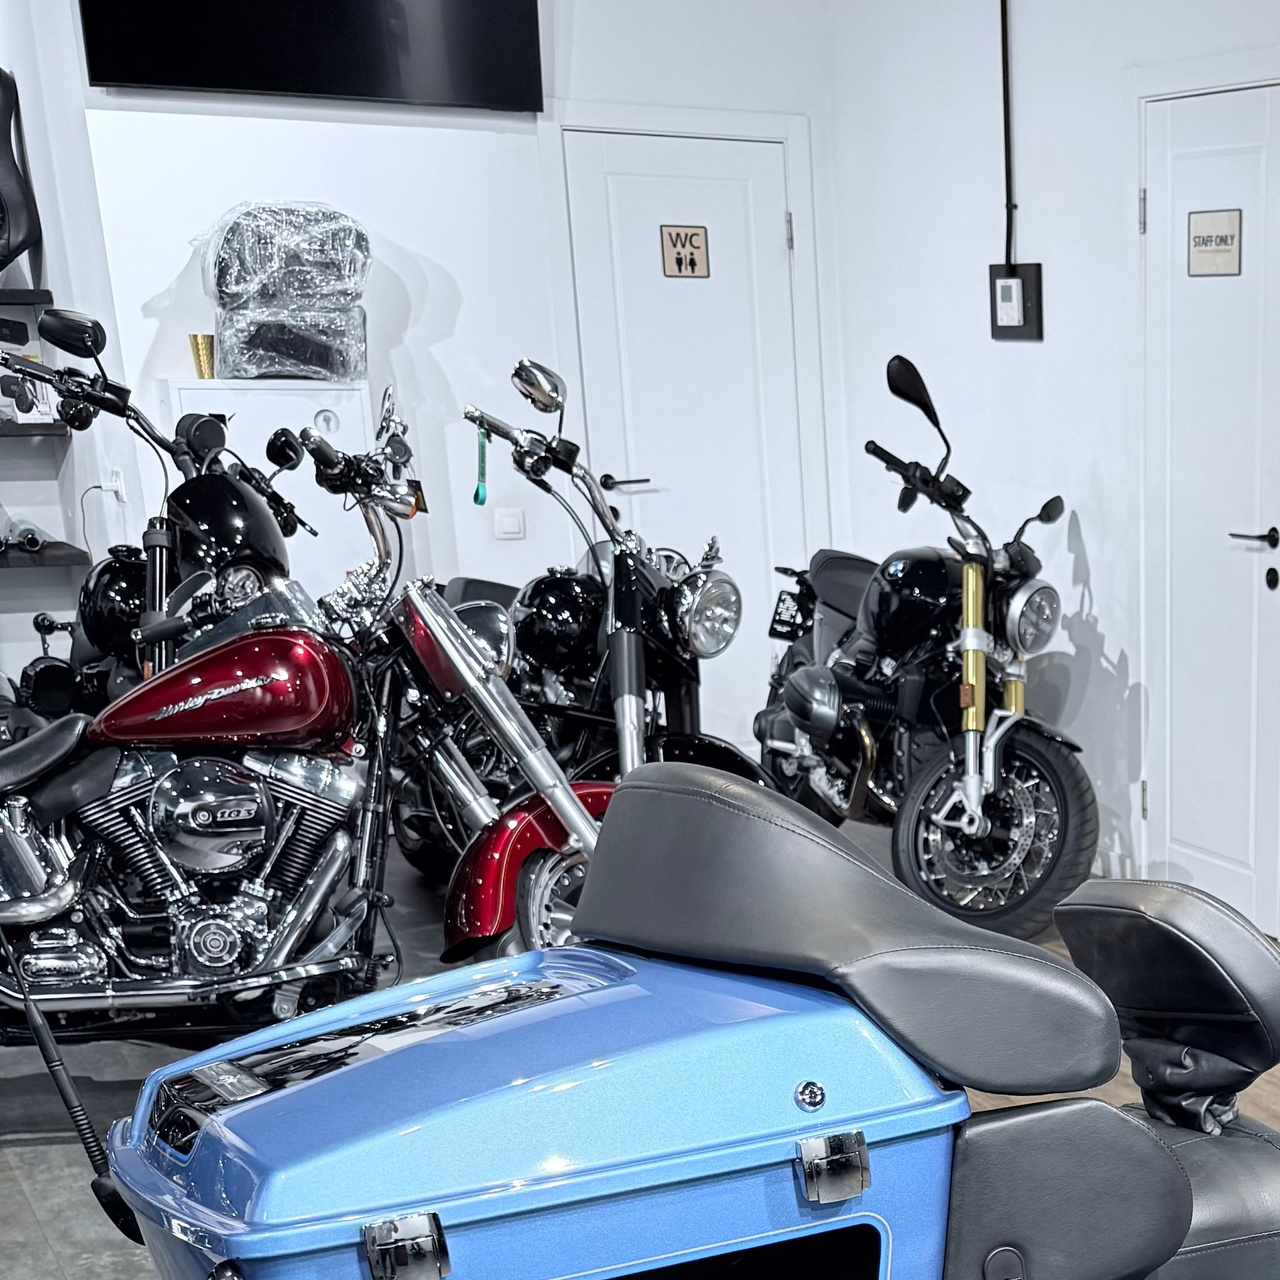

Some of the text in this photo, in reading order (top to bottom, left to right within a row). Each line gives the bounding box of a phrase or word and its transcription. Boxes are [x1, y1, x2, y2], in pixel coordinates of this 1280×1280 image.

[668, 232, 701, 249] WC
[1193, 234, 1235, 247] STAFF ONLY
[217, 808, 256, 820] 103
